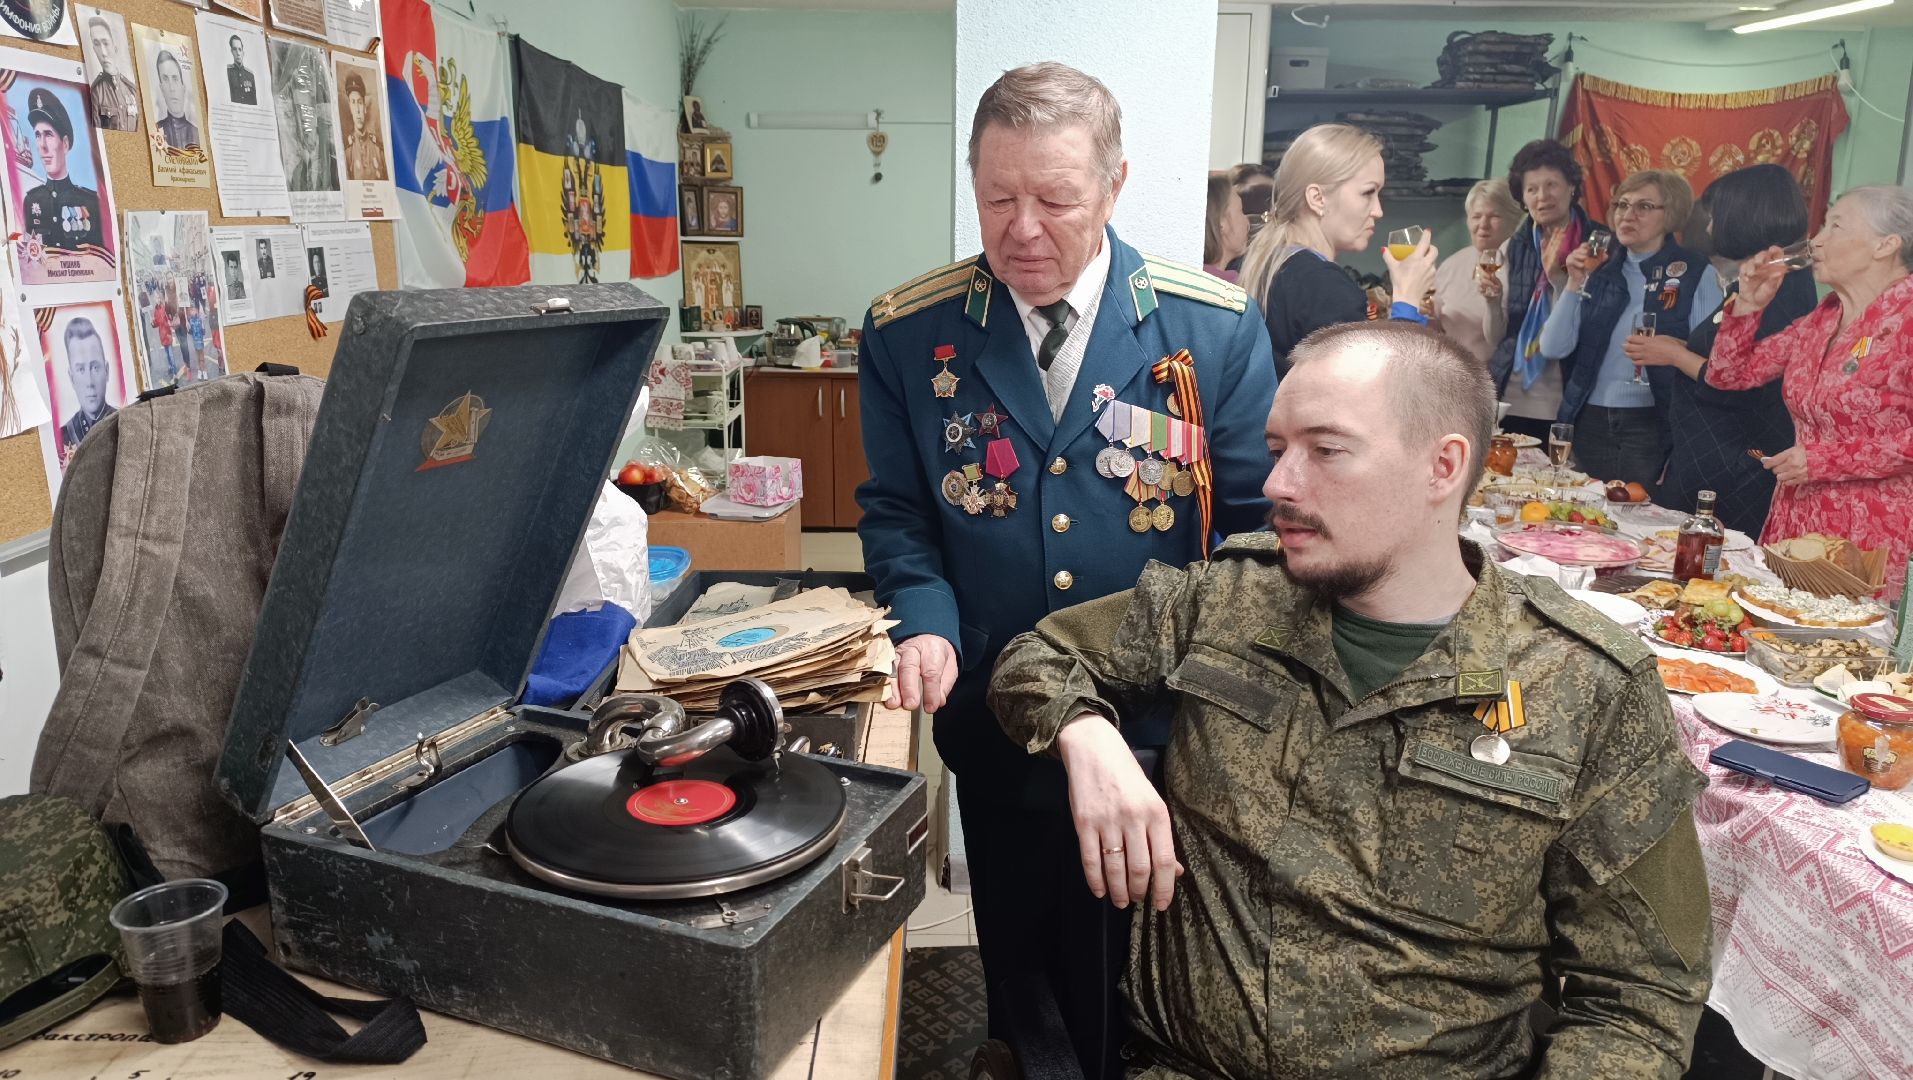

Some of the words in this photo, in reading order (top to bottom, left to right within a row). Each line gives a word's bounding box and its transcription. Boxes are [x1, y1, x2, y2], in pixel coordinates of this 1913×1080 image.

[0, 0, 42, 34] ИМФОНИЯ
[1488, 769, 1514, 784] СИЛЫ
[1518, 774, 1554, 796] РОССИИ
[904, 979, 983, 1034] REPLEX
[920, 969, 988, 1017] REPLE
[902, 997, 963, 1045] EPLEX
